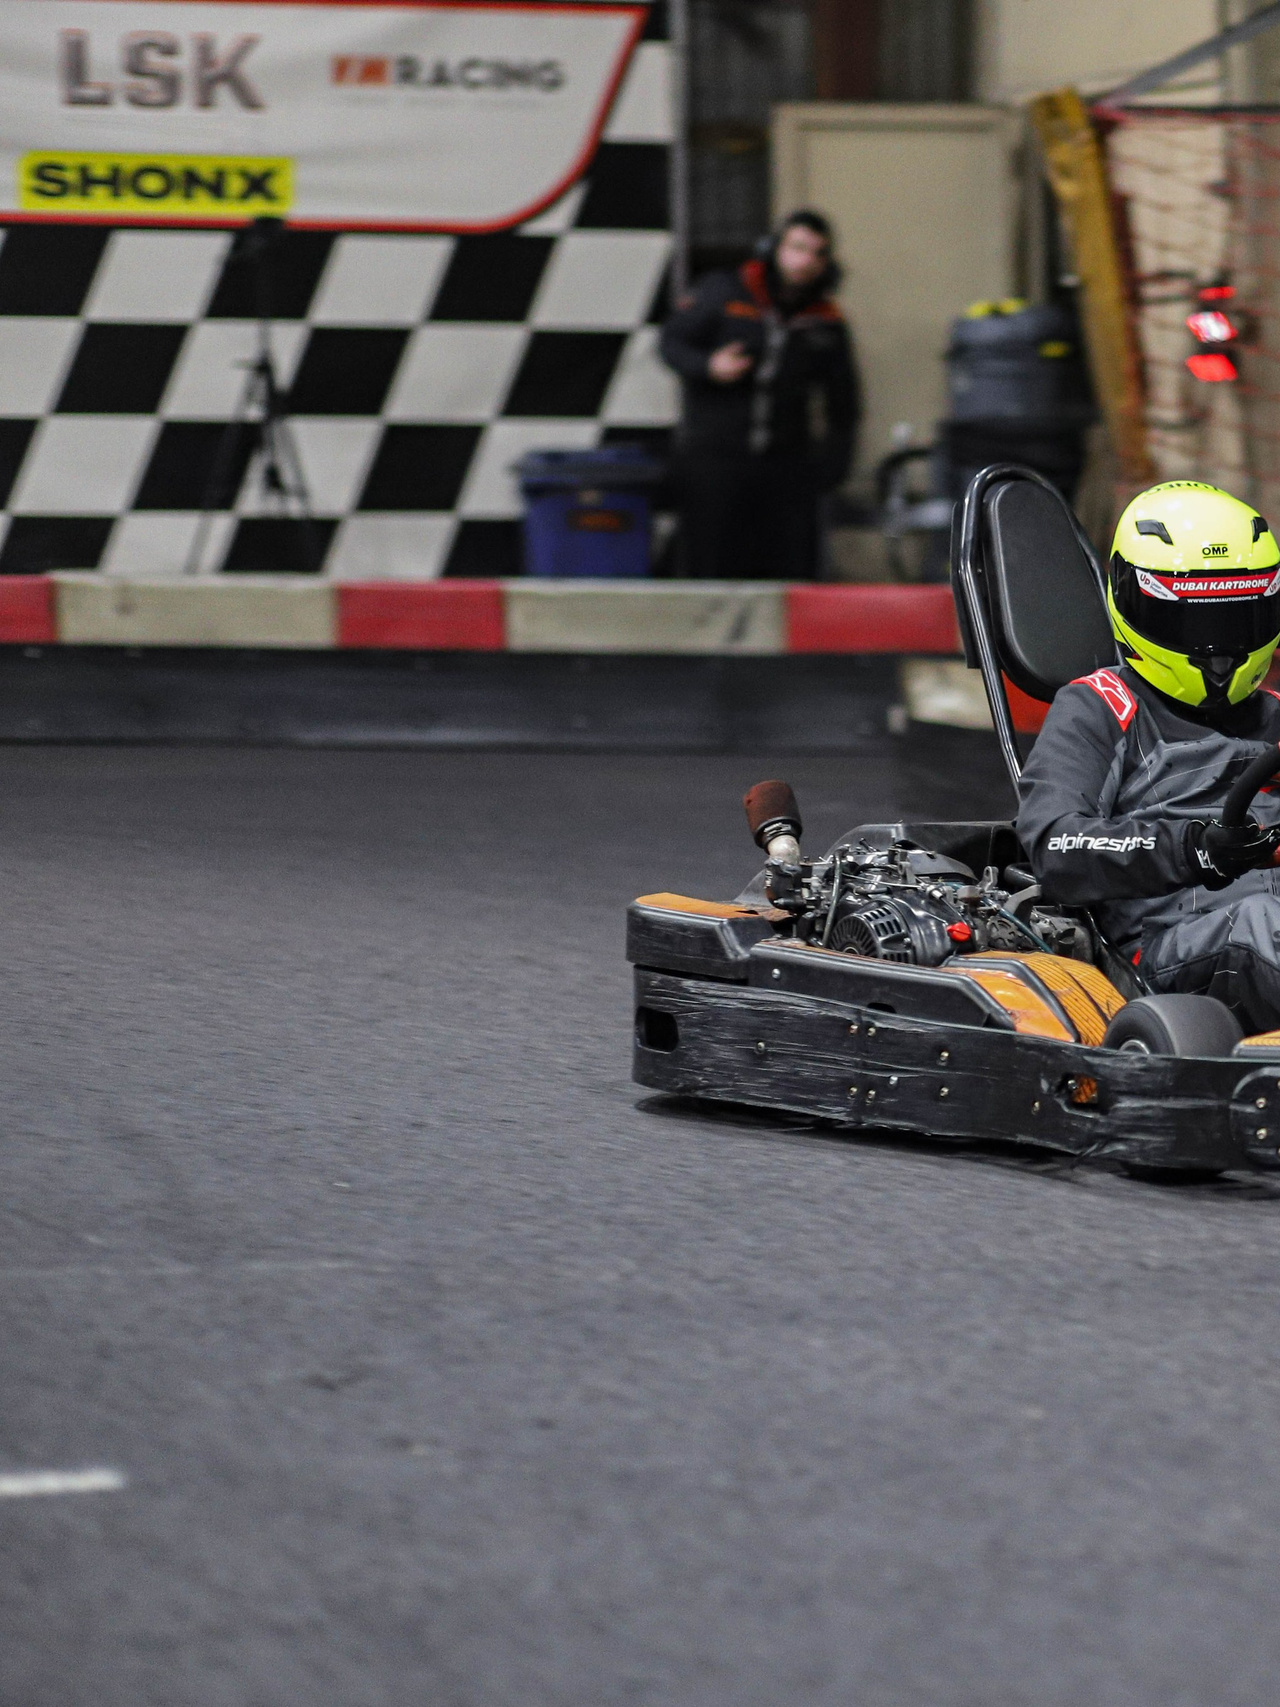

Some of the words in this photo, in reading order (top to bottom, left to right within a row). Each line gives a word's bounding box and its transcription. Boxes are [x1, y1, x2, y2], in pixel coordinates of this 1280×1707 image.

[58, 28, 267, 111] LSK
[396, 55, 565, 93] RACING
[31, 161, 279, 204] SHONX
[1202, 546, 1228, 556] OMP
[1172, 582, 1207, 591] DUBAI
[1209, 578, 1269, 591] KARTDROME
